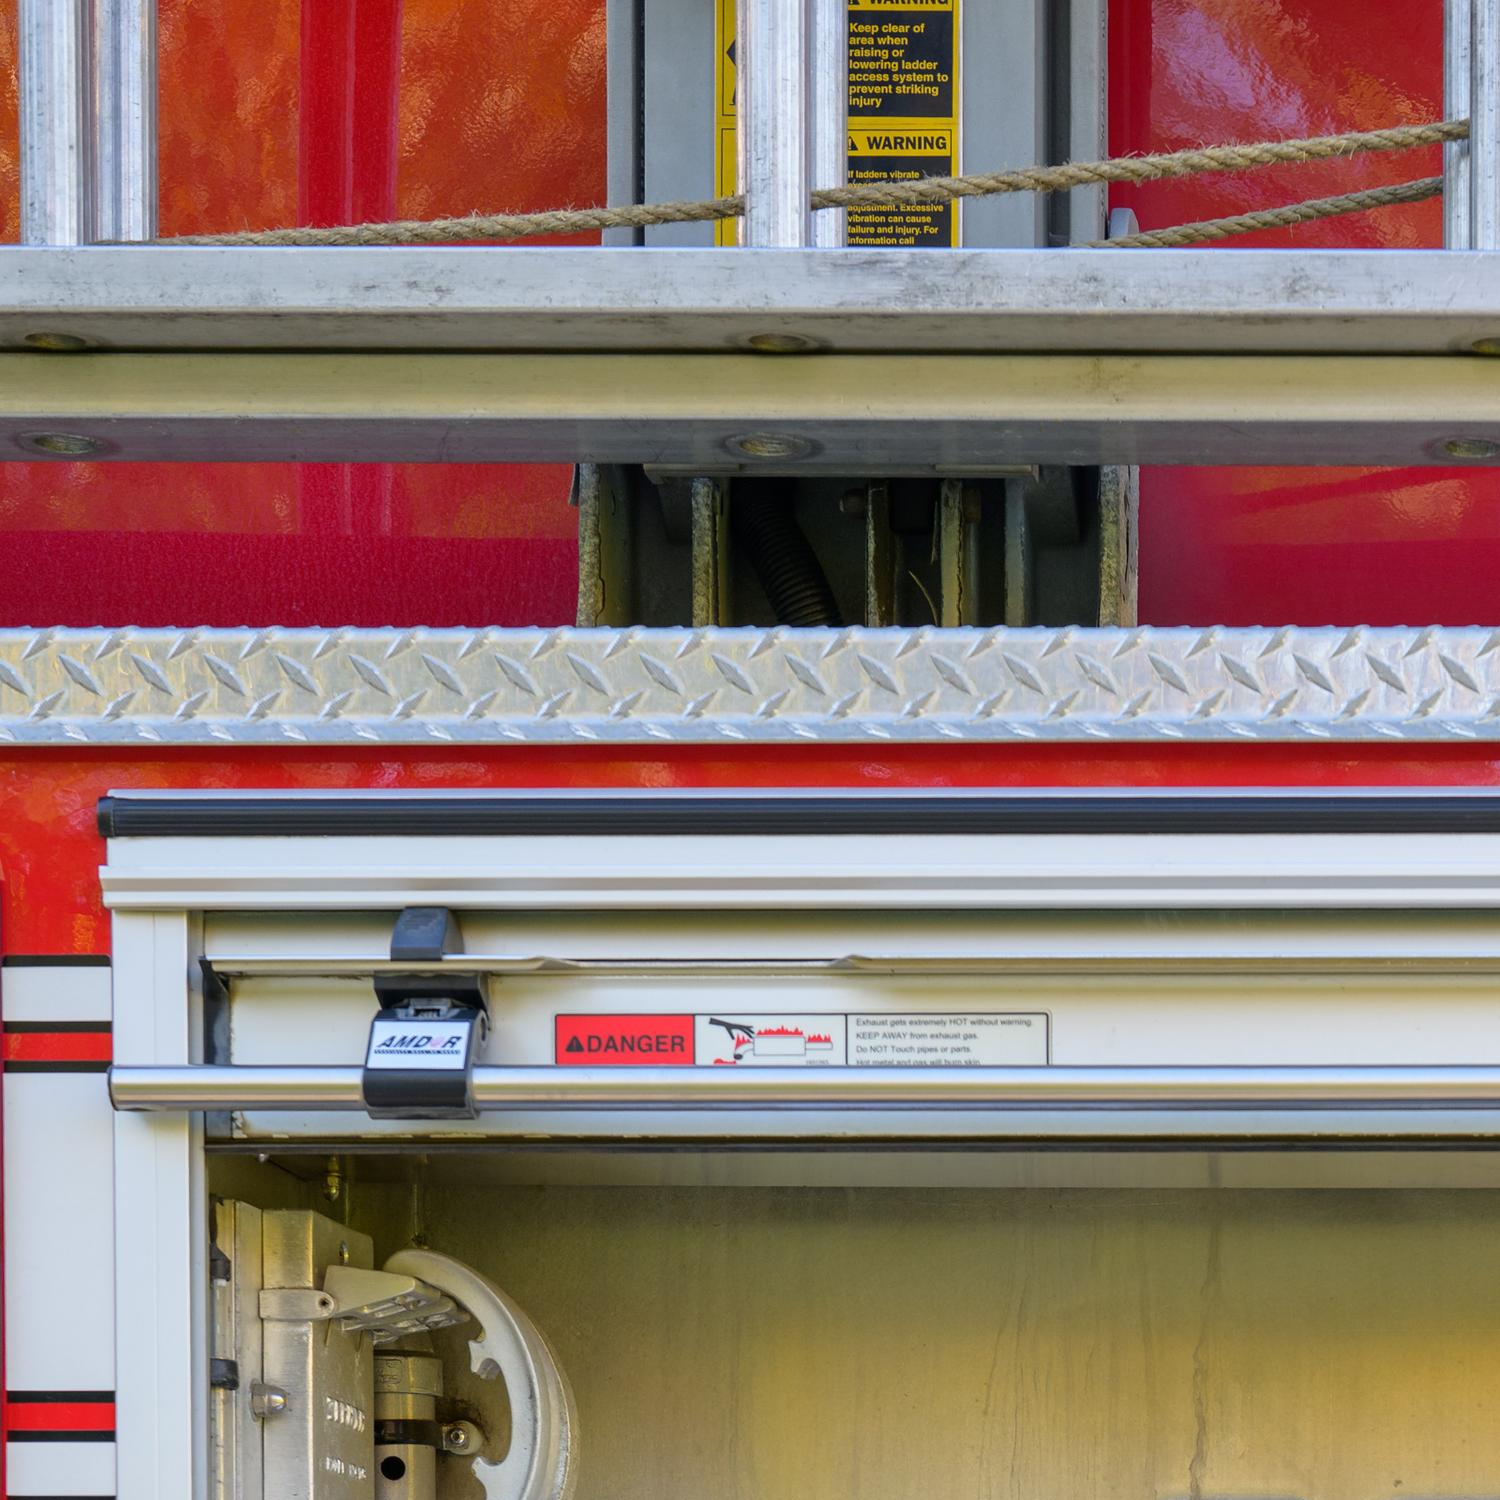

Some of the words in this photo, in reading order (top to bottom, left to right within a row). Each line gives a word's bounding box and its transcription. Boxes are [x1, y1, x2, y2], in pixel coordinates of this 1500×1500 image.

[850, 23, 878, 34] Keep
[882, 24, 910, 33] clear
[913, 23, 925, 33] of
[849, 37, 874, 45] area
[877, 36, 908, 45] when
[849, 48, 888, 59] raising
[892, 49, 904, 57] or
[850, 60, 898, 71] lowering
[902, 60, 938, 70] ladder
[849, 73, 889, 81] access
[893, 73, 933, 83] system
[937, 73, 948, 82] to
[849, 85, 892, 95] prevent
[896, 84, 939, 96] striking
[850, 96, 882, 108] injury
[867, 136, 946, 150] WARNING
[848, 170, 854, 178] If
[856, 170, 887, 178] ladders
[890, 170, 919, 178] vibrate
[900, 204, 944, 212] Excessive
[848, 214, 885, 223] vibration
[848, 226, 875, 234] failure
[877, 226, 894, 234] and
[896, 226, 921, 235] injury.
[856, 1018, 887, 1026] Exhaust
[890, 1019, 906, 1027] gets
[909, 1018, 946, 1027] extremely
[950, 1018, 967, 1026] HOT
[970, 1018, 998, 1026] without
[588, 1036, 684, 1052] DANGER
[917, 1046, 938, 1054] pipes
